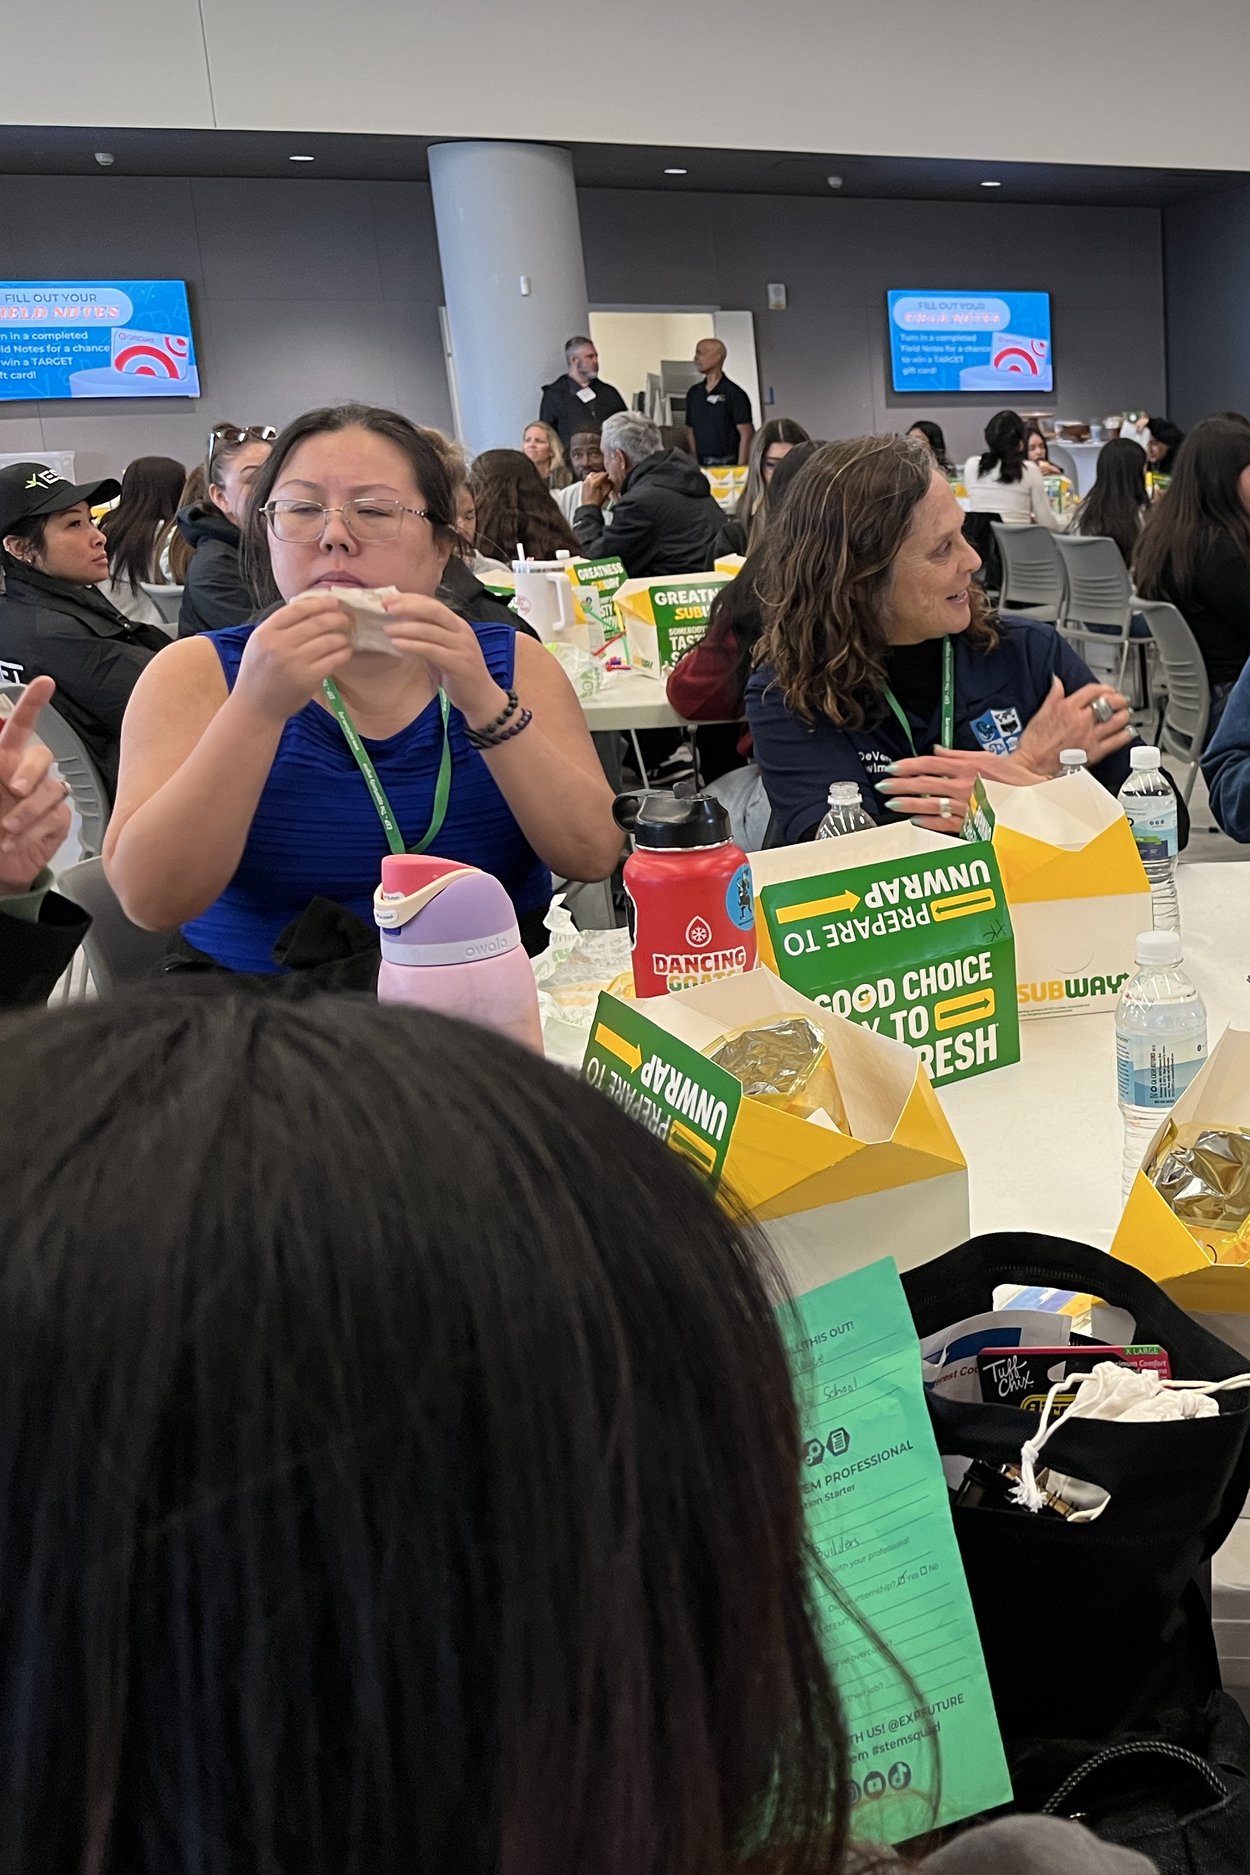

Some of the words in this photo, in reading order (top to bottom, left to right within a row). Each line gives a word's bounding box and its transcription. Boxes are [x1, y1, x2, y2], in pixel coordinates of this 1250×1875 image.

[5, 294, 30, 303] FILL
[33, 294, 60, 303] OUT
[61, 294, 97, 303] YOUR
[918, 302, 937, 310] FILL
[938, 302, 957, 310] OUT
[960, 302, 986, 310] YOUR
[0, 306, 47, 320] IELD
[51, 306, 120, 320] NOTES
[10, 332, 20, 340] in
[32, 331, 89, 341] completed
[14, 345, 45, 353] Notes
[46, 345, 61, 353] for
[72, 344, 110, 353] chance
[1, 357, 21, 366] win
[31, 356, 73, 366] TARGET
[10, 371, 37, 379] card!
[577, 562, 624, 581] GREATNESS
[654, 588, 719, 606] GREATN
[674, 607, 710, 621] SUB
[864, 859, 992, 909] UNWRAP
[822, 903, 931, 948] PREPARE
[464, 937, 508, 957] owala
[784, 931, 821, 956] TO
[653, 946, 746, 975] DANCING
[902, 952, 993, 1001] CHOICE
[1018, 973, 1131, 1004] SUBWAY
[890, 1004, 929, 1044] TO
[914, 1023, 998, 1080] RESH
[640, 1054, 728, 1141] UNWRAP
[829, 1320, 855, 1338] OUT!
[1131, 1347, 1159, 1356] LARGE
[983, 1355, 1028, 1384] Tuff
[1138, 1360, 1167, 1369] Comfort
[823, 1375, 859, 1401] School
[998, 1374, 1034, 1398] Chix
[802, 1477, 822, 1494] EM
[825, 1440, 914, 1487] PROFESSIONAL
[824, 1483, 856, 1502] Starter
[849, 1554, 867, 1570] your
[907, 1571, 920, 1582] Yes
[928, 1563, 939, 1573] No
[866, 1723, 886, 1739] US!
